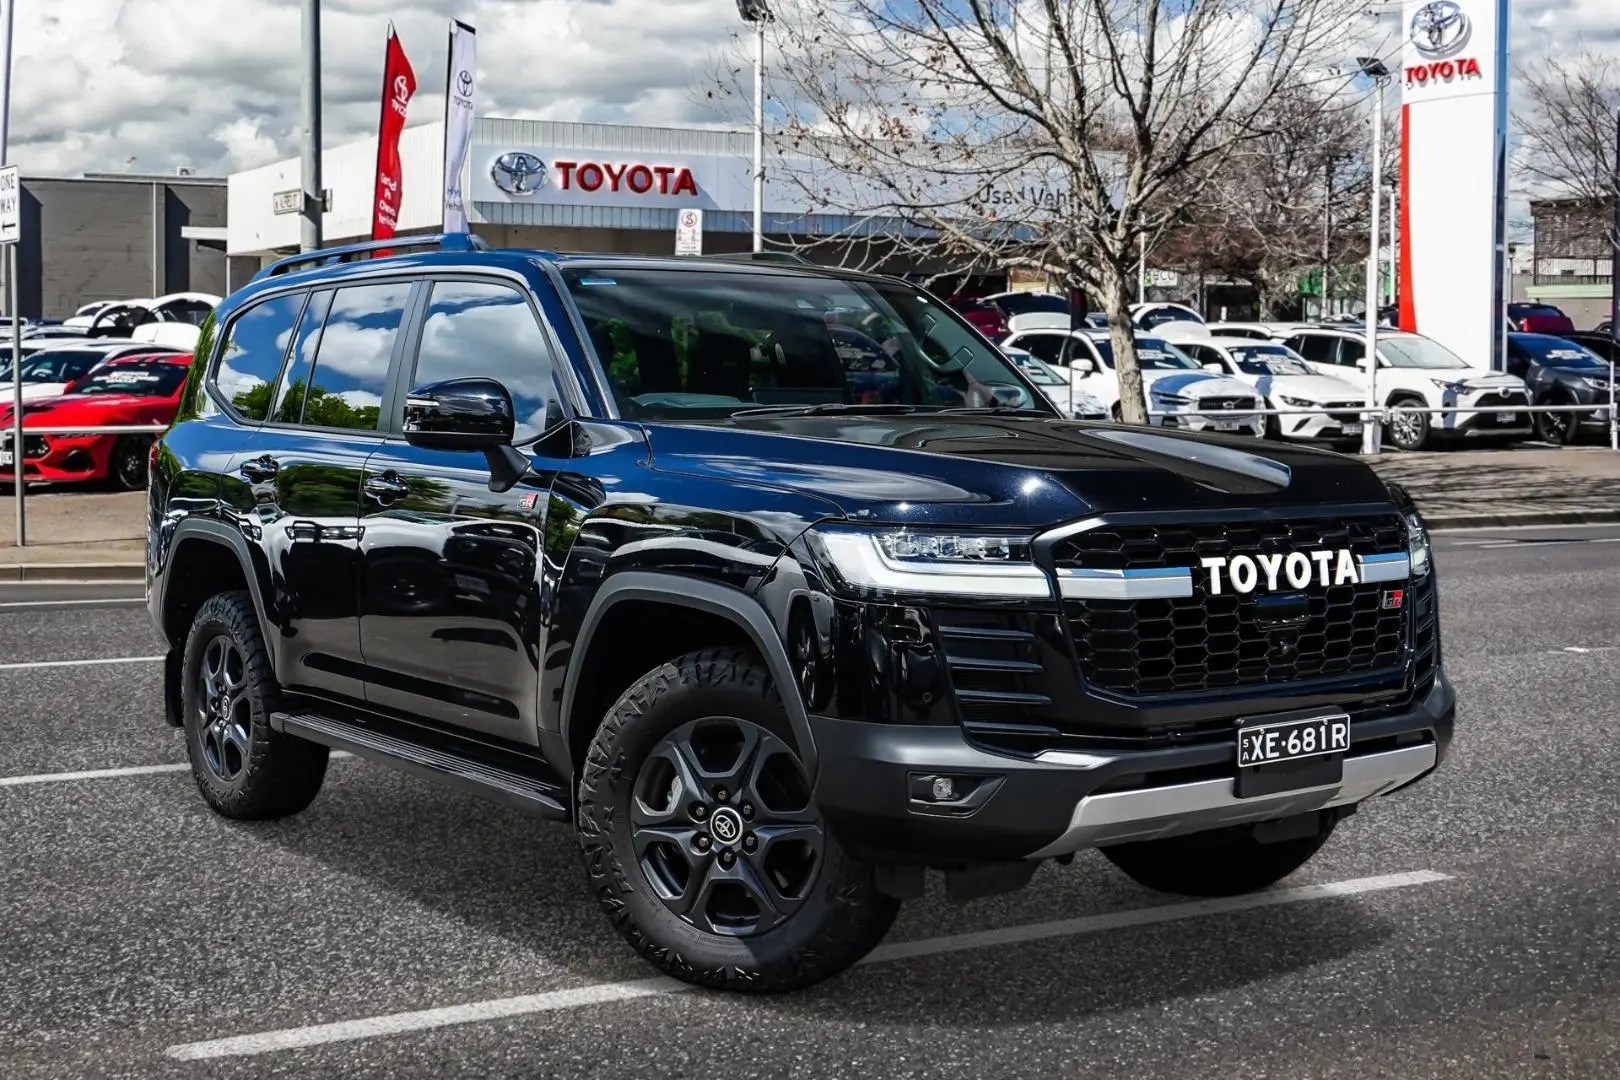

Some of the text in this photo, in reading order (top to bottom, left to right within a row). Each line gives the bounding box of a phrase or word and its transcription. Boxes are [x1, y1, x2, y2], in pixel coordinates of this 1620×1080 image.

[1404, 58, 1480, 82] TOYOTA
[1, 173, 15, 191] ONE
[555, 162, 698, 196] TOYOTA
[0, 196, 16, 213] WAY
[1201, 549, 1359, 595] TOYOTA
